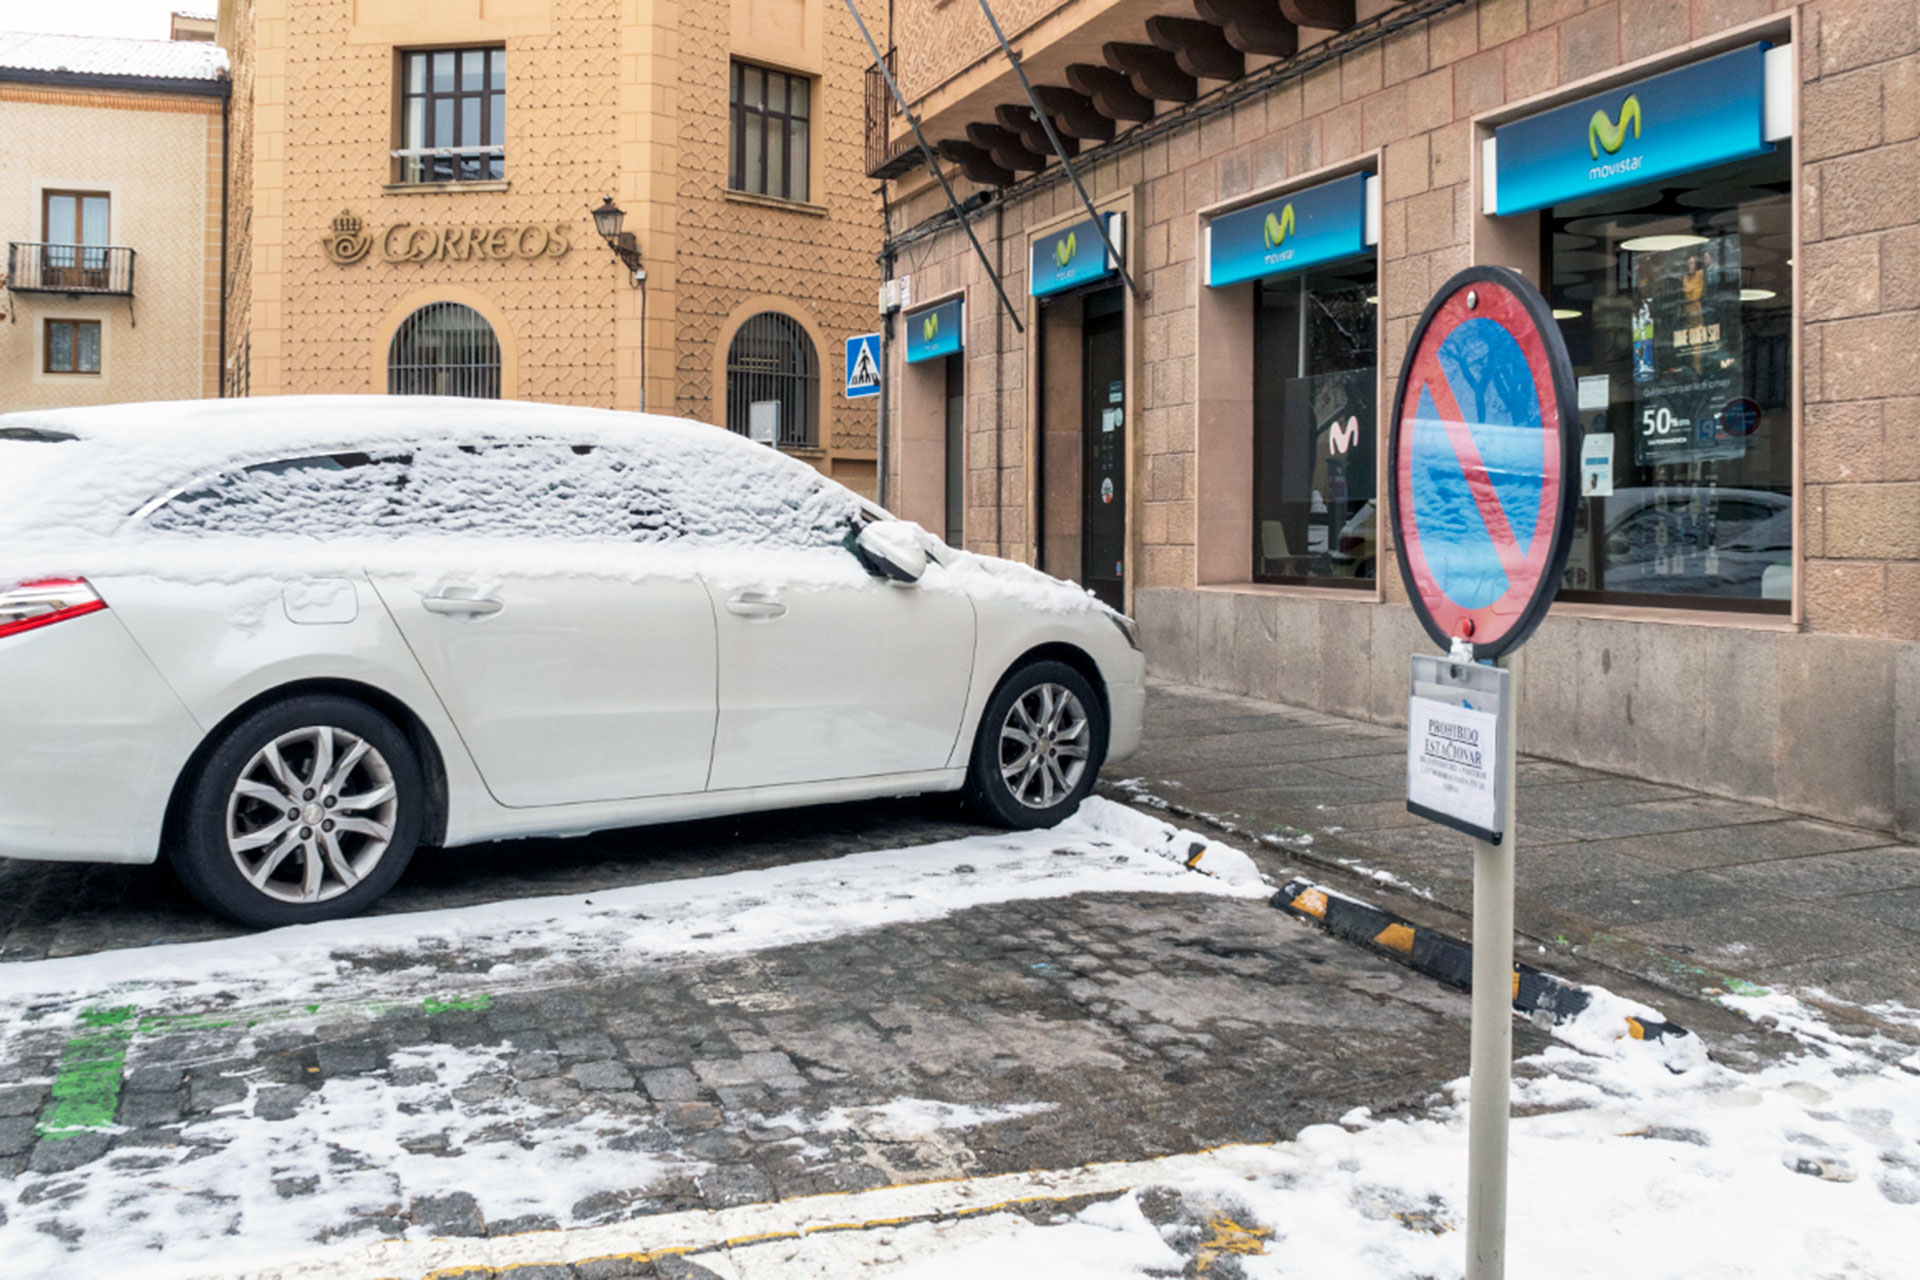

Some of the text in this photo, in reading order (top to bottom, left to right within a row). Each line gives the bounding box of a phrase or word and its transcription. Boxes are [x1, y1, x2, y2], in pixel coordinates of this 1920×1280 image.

[1588, 156, 1643, 180] movistar
[381, 223, 573, 264] CORREOS
[1428, 719, 1479, 743] PROHIBIDO
[1425, 739, 1482, 766] ESTACIONAR
